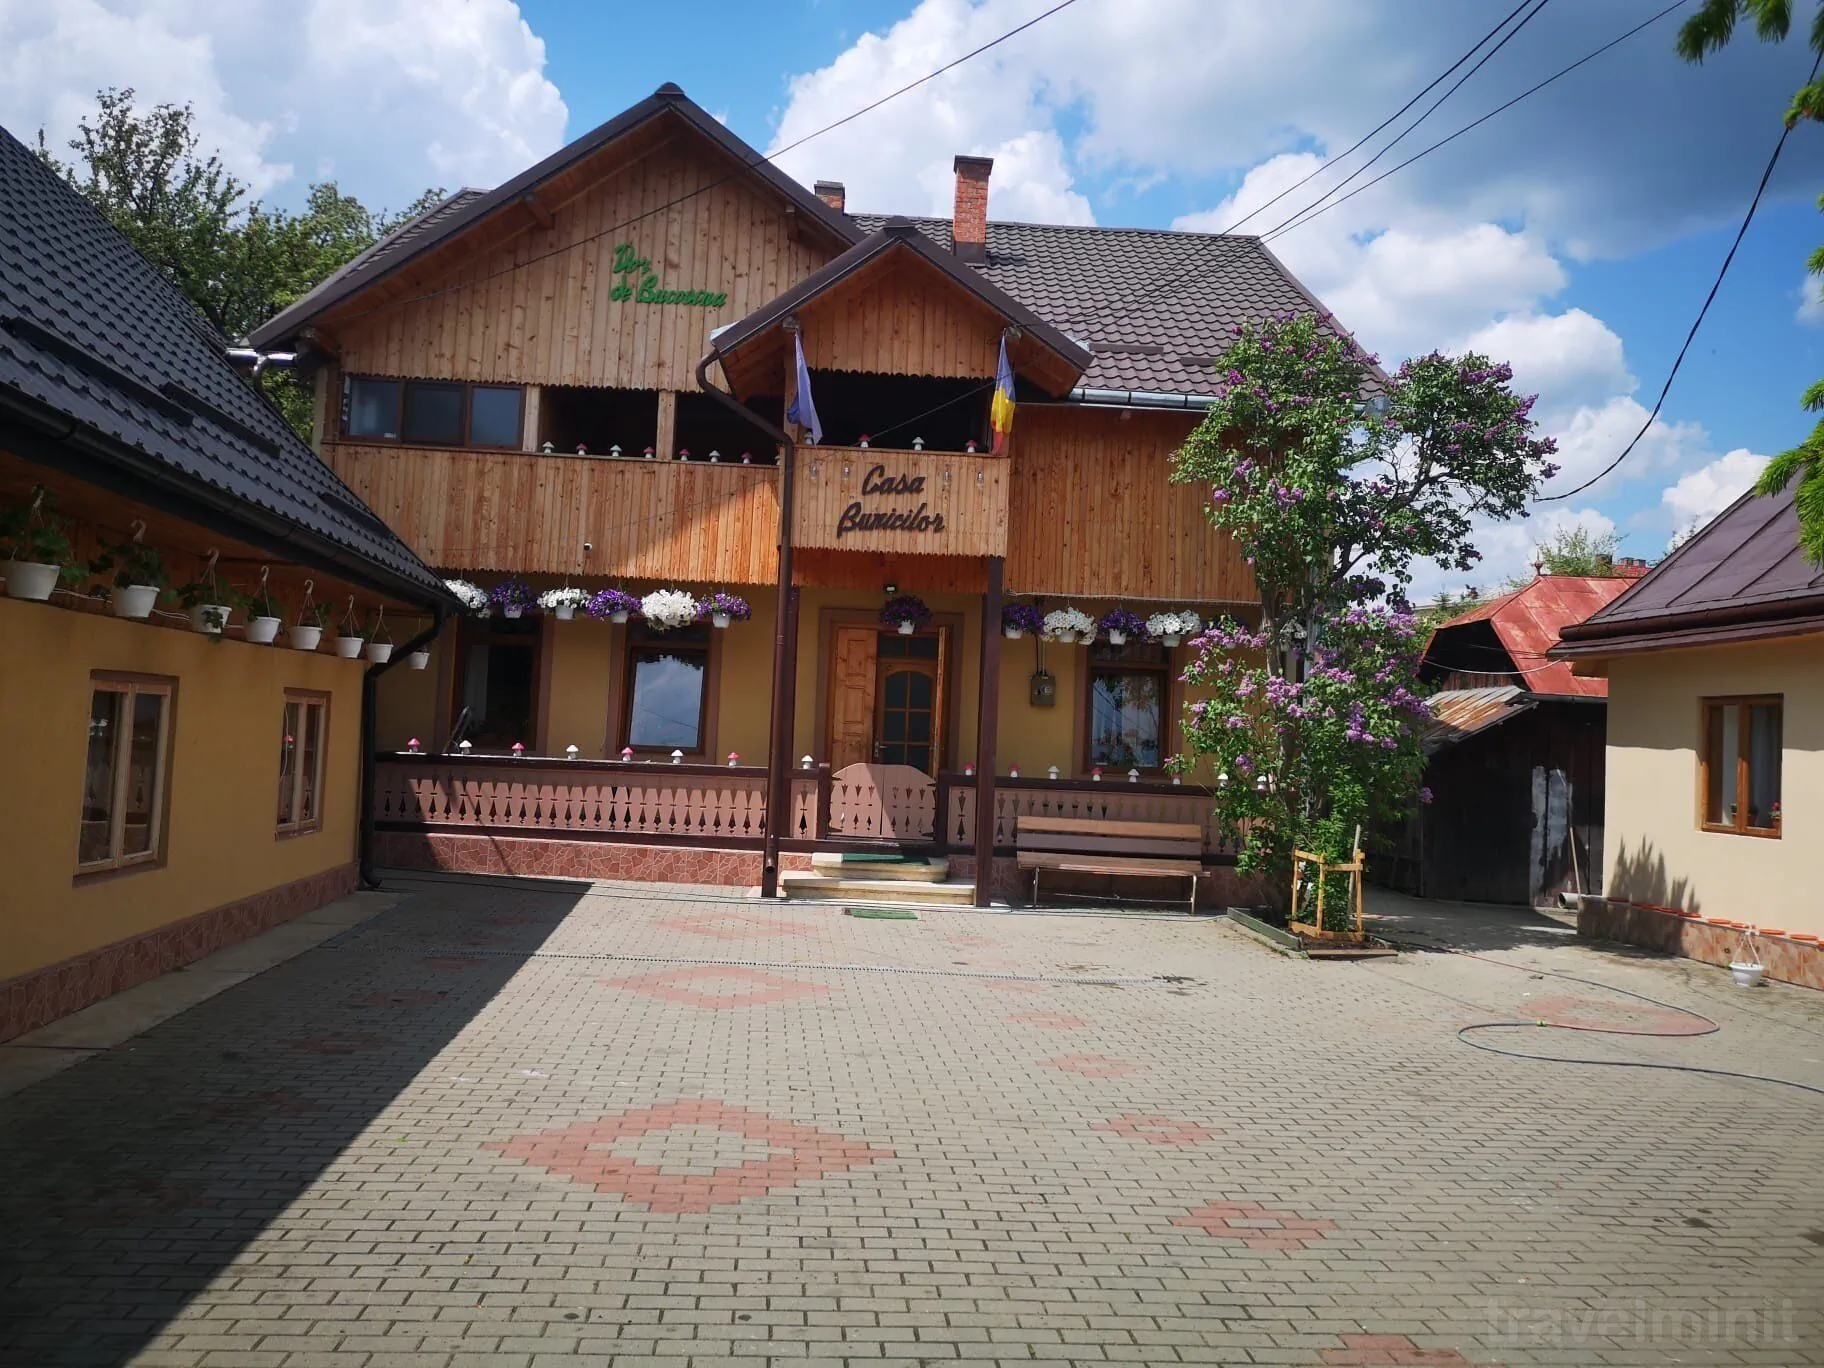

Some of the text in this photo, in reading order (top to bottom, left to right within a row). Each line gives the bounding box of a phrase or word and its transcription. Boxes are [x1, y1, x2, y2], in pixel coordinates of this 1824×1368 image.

[610, 274, 633, 302] de
[862, 465, 926, 496] Casa
[837, 502, 945, 539] Bunicilor
